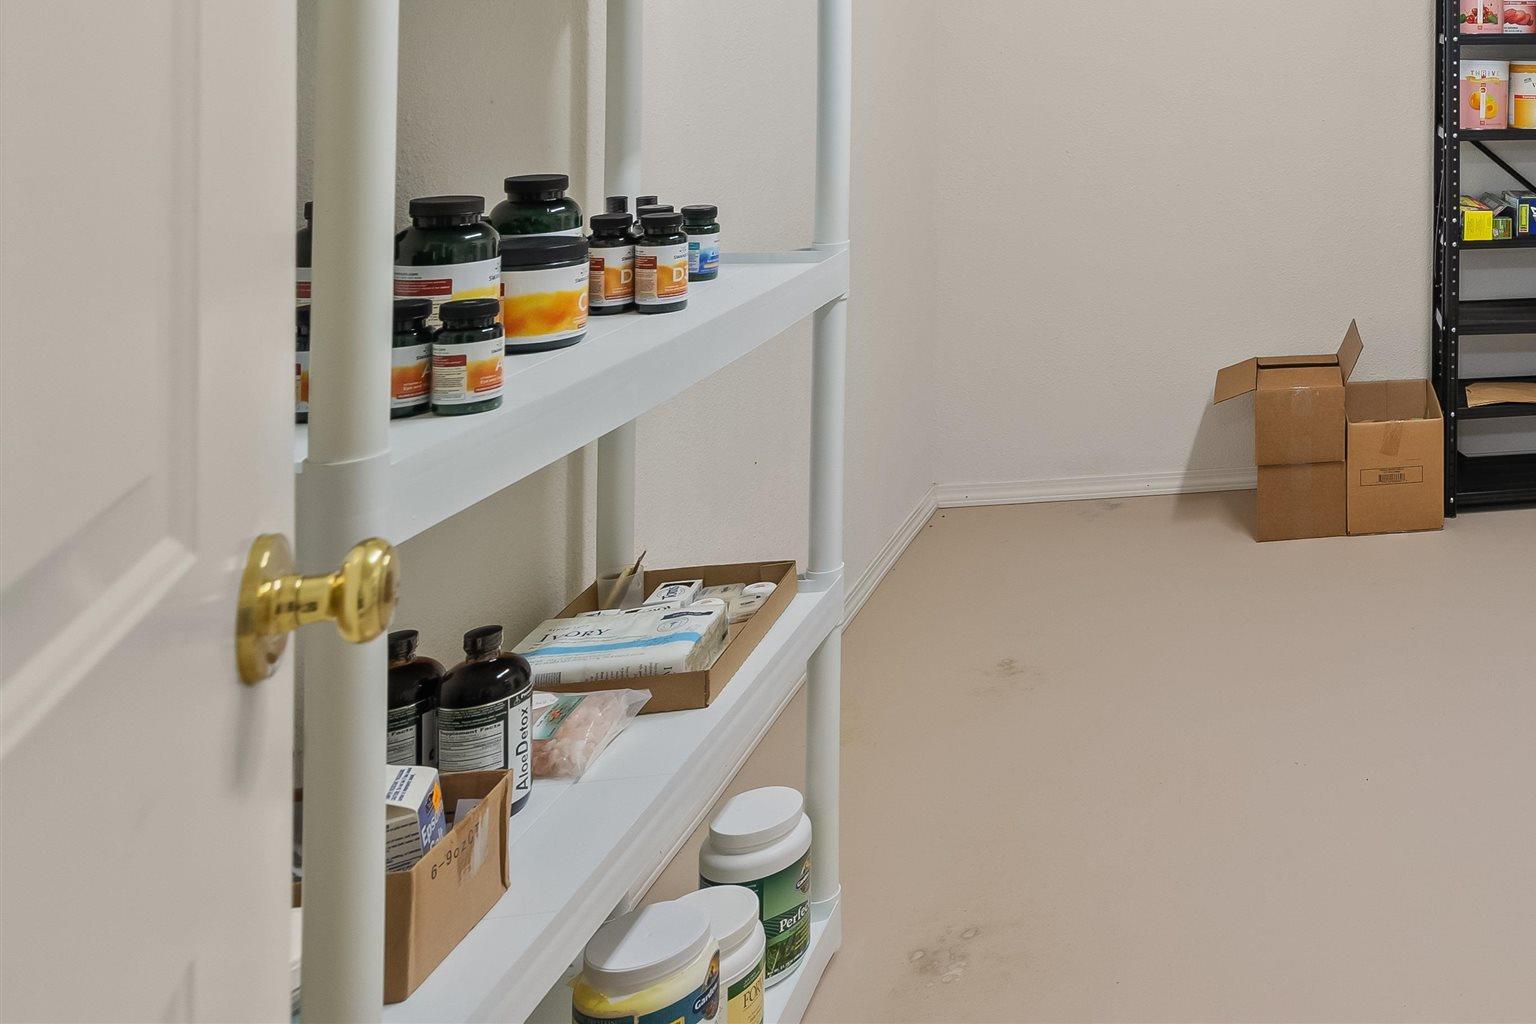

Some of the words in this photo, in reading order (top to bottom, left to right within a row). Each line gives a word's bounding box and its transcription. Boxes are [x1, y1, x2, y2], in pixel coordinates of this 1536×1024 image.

[540, 628, 611, 643] IVORY
[440, 728, 478, 736] Supplement
[480, 723, 502, 733] Facts
[515, 706, 528, 790] AloeDetox
